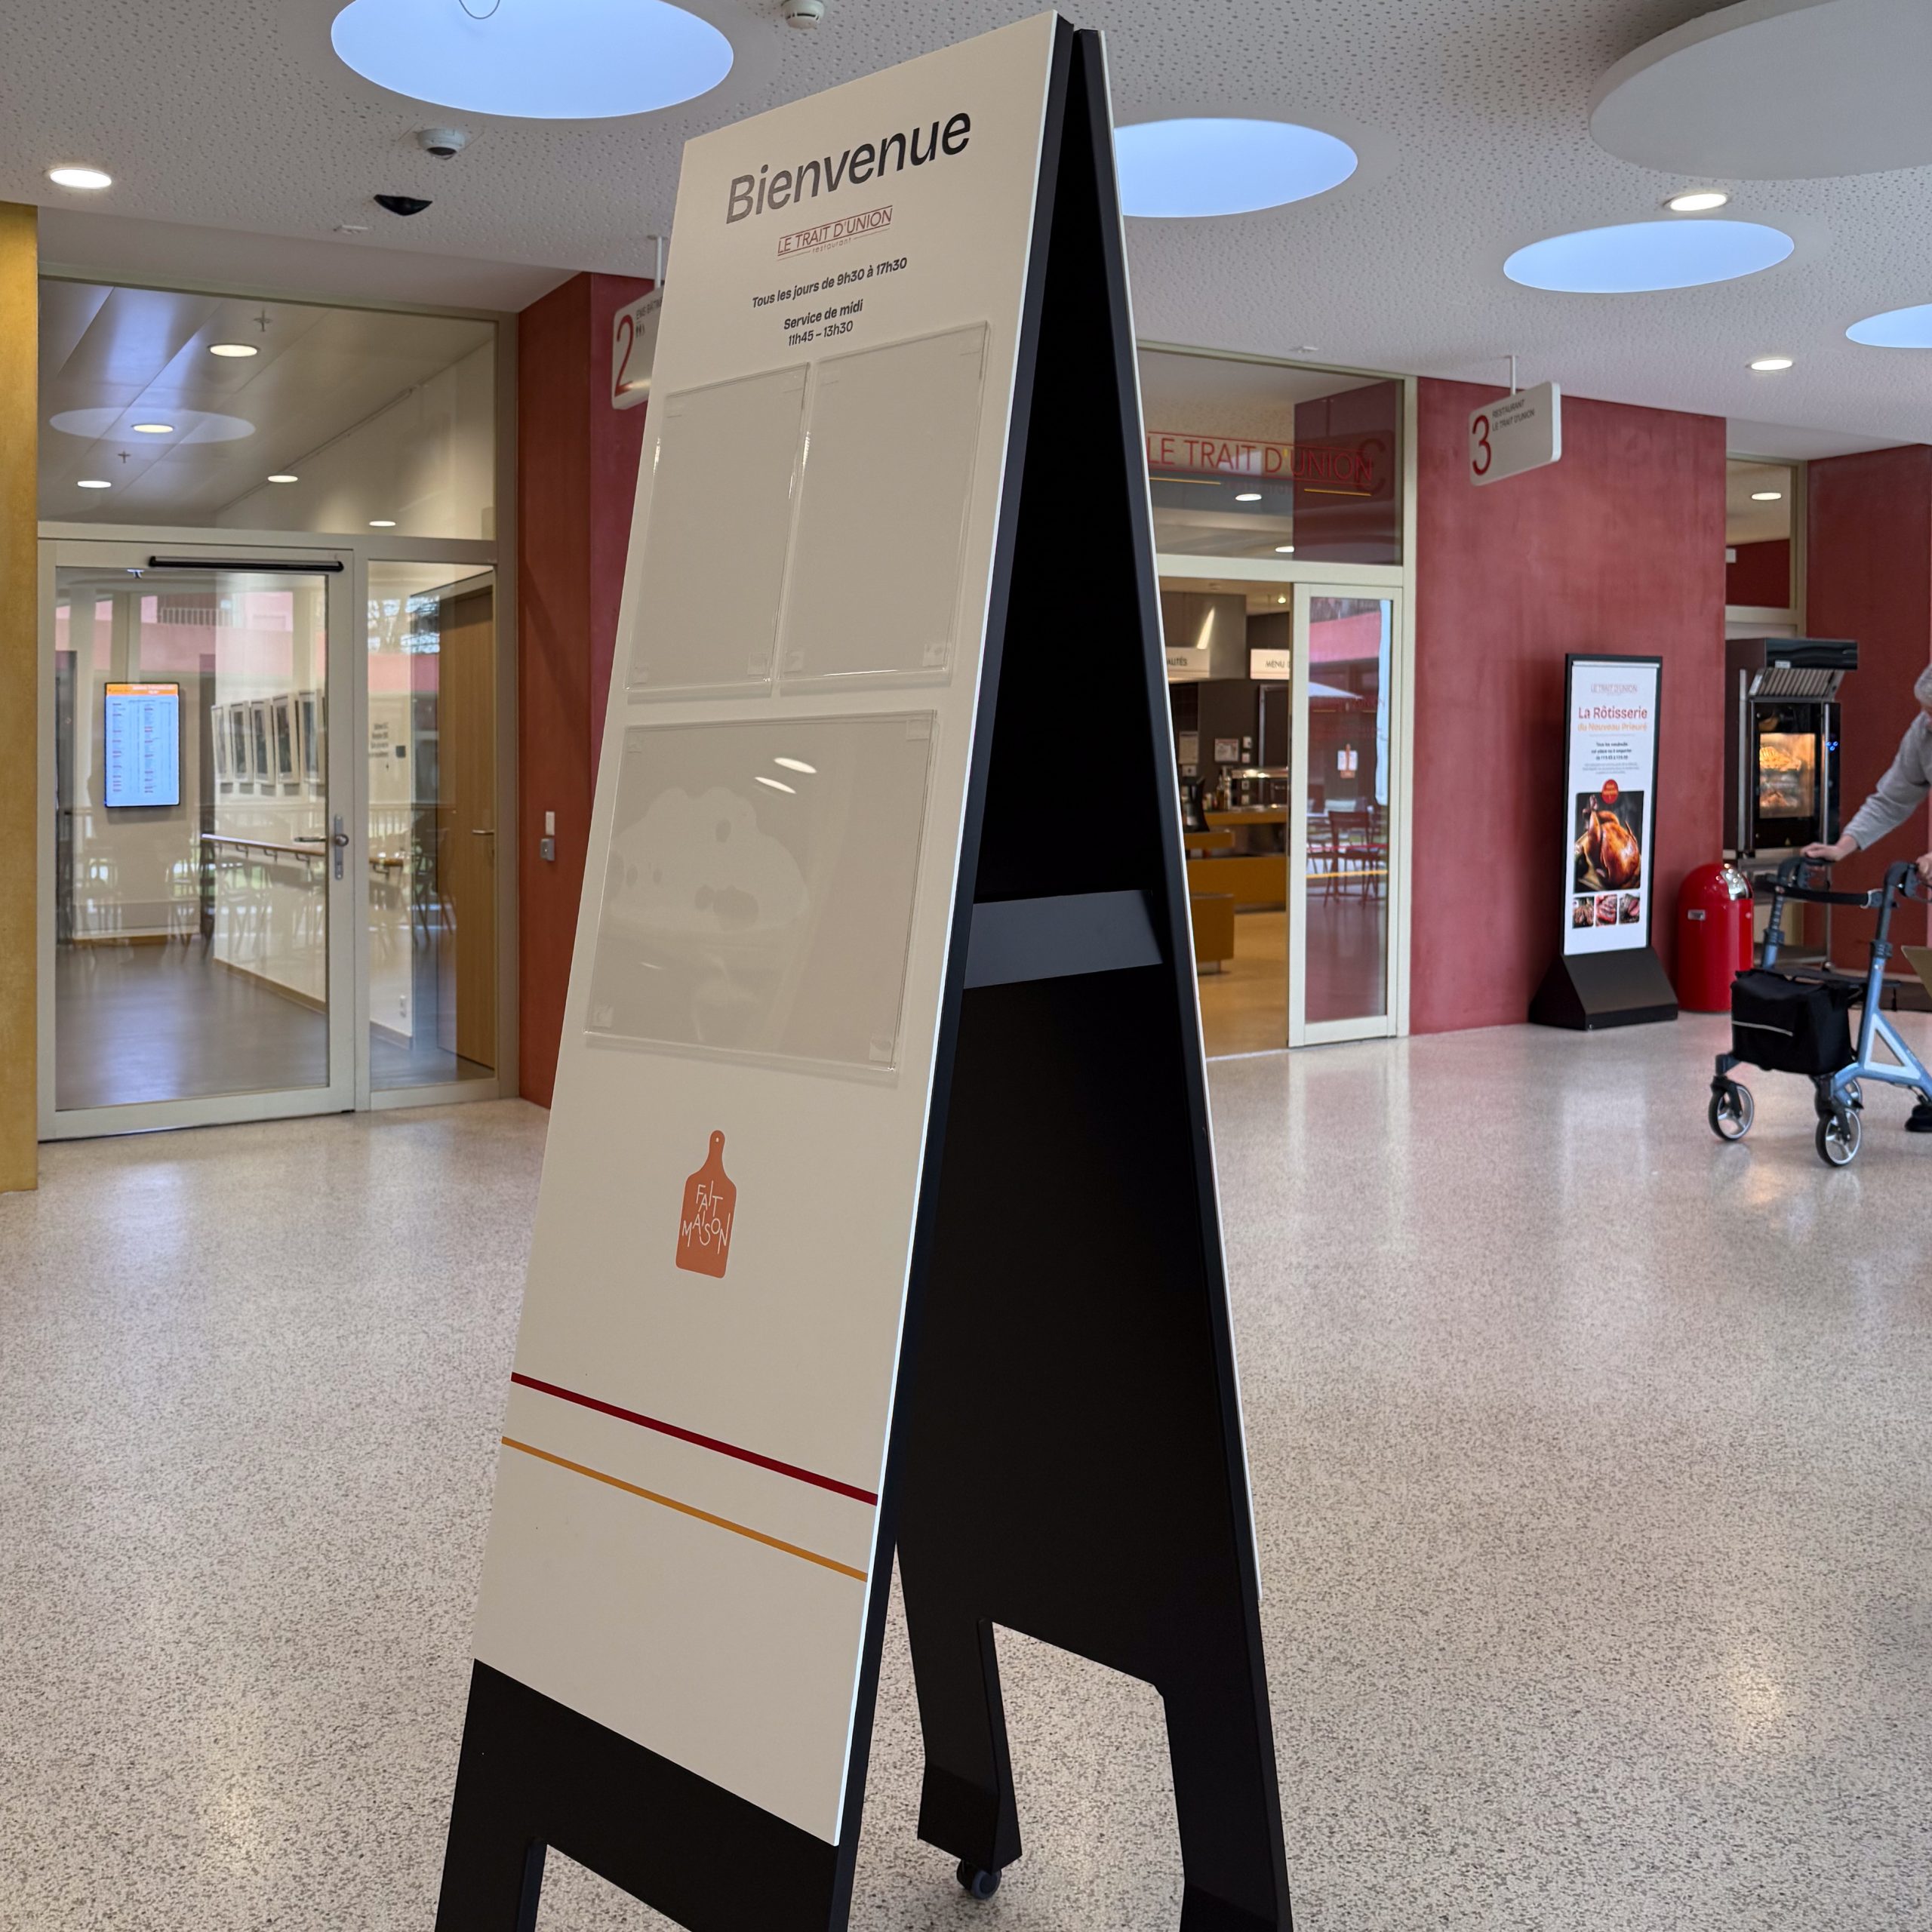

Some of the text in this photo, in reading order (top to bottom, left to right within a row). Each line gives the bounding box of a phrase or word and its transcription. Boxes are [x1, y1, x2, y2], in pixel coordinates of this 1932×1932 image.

[726, 112, 971, 224] Bienvenue
[777, 208, 893, 254] LE TRAIT D'UNION
[812, 237, 852, 253] restaurant
[752, 257, 908, 308] Tous les jours de 9h30 à 17h30
[783, 299, 863, 330] Service de midi
[789, 330, 814, 346] 11h45
[823, 320, 854, 337] 13h30
[614, 314, 634, 397] 2
[1492, 398, 1525, 417] RESTAURANT
[1146, 436, 1372, 481] LE TRAIT D'UNION
[1472, 415, 1491, 475] 3
[1578, 706, 1647, 719] La Rôtisserie
[696, 1180, 724, 1217] FAIT
[681, 1209, 731, 1254] MAISON
